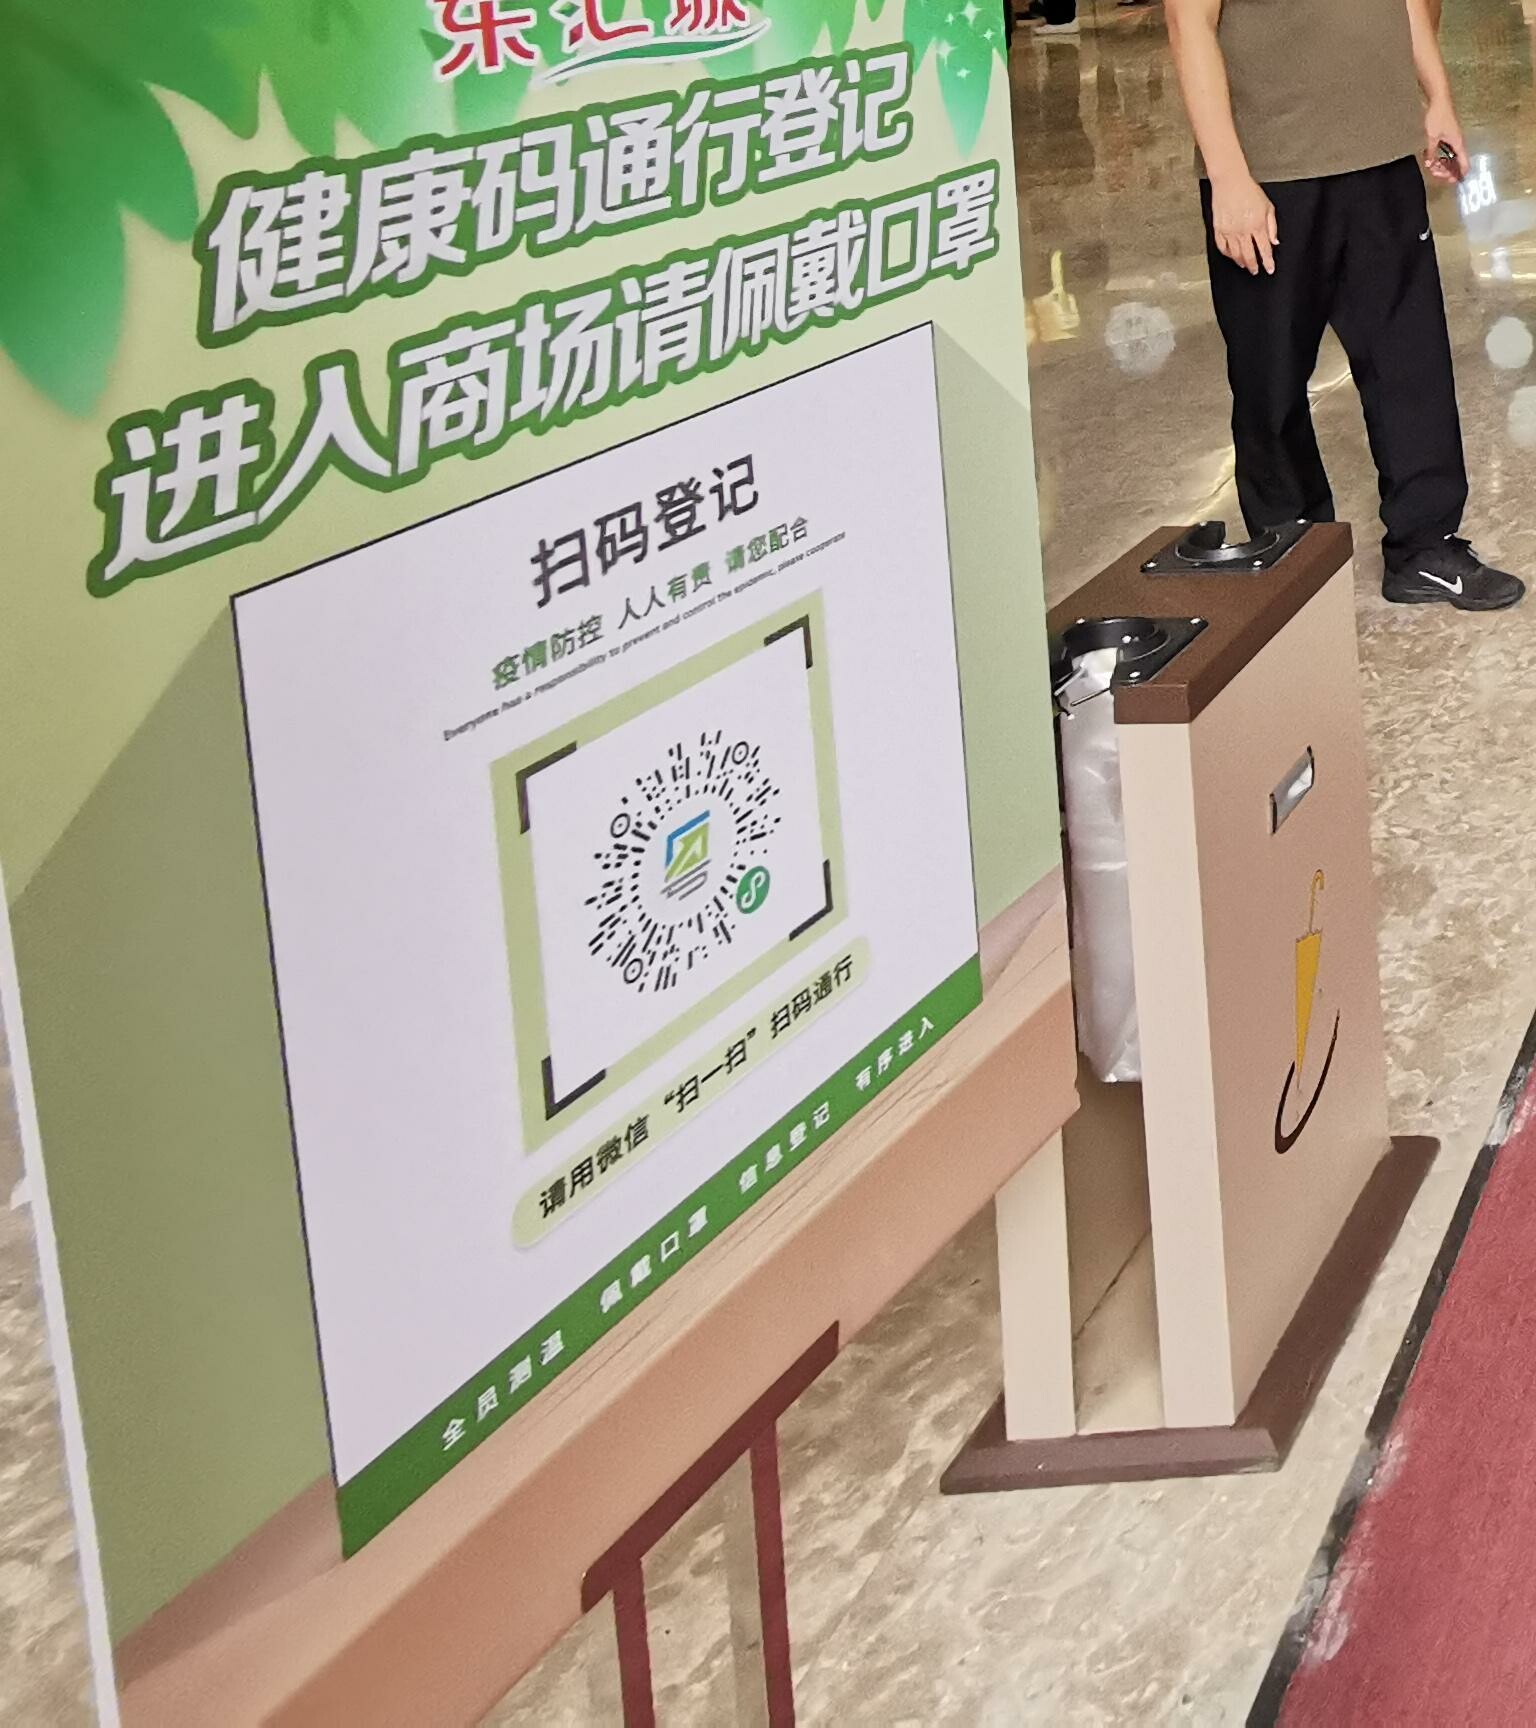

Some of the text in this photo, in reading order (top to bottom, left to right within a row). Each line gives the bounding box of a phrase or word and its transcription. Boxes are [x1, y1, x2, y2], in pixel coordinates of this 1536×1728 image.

[209, 52, 911, 331] 健康码通行登记
[103, 176, 998, 581] 进入商场请佩戴口罩
[492, 516, 808, 691] 疫情防控 人人有责 请您配合
[530, 454, 760, 609] 扫码登记
[538, 1115, 650, 1219] 请用微信
[770, 953, 855, 1040] 扫码通行
[439, 1015, 936, 1451] 全员测温 佩戴口罩 信息登记 有序进入
